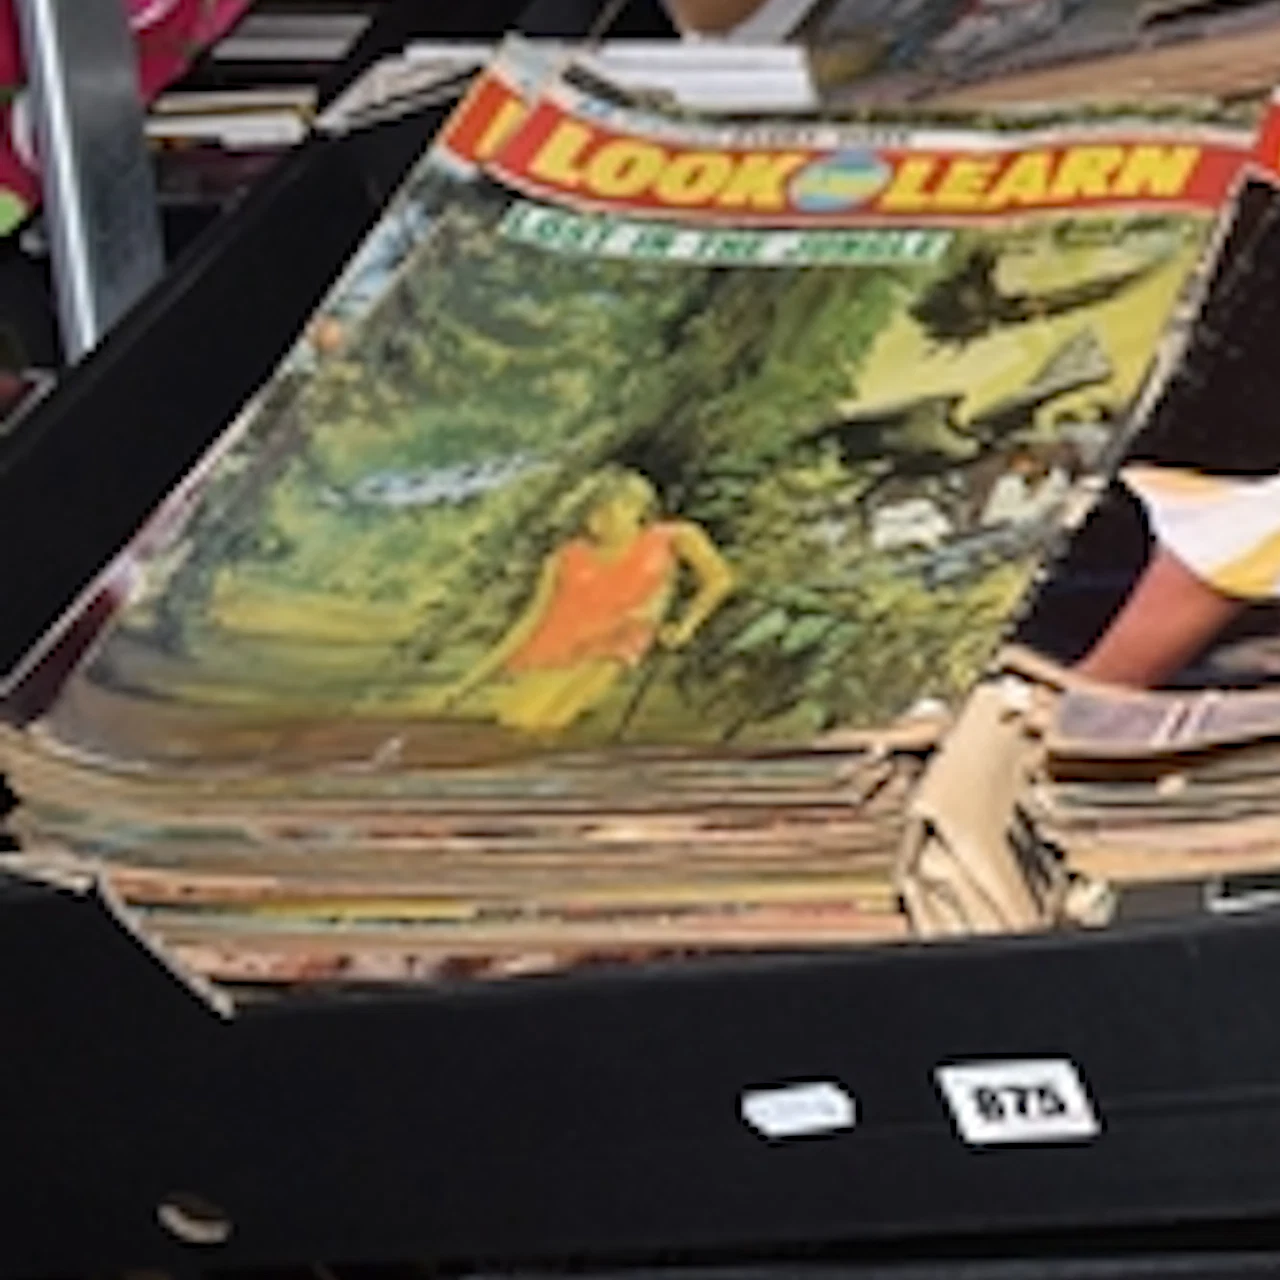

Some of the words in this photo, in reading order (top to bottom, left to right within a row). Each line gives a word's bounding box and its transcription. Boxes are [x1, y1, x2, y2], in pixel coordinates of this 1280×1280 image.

[530, 122, 806, 210] LOOK
[880, 143, 1204, 211] LEARN
[974, 1084, 1066, 1123] 875
